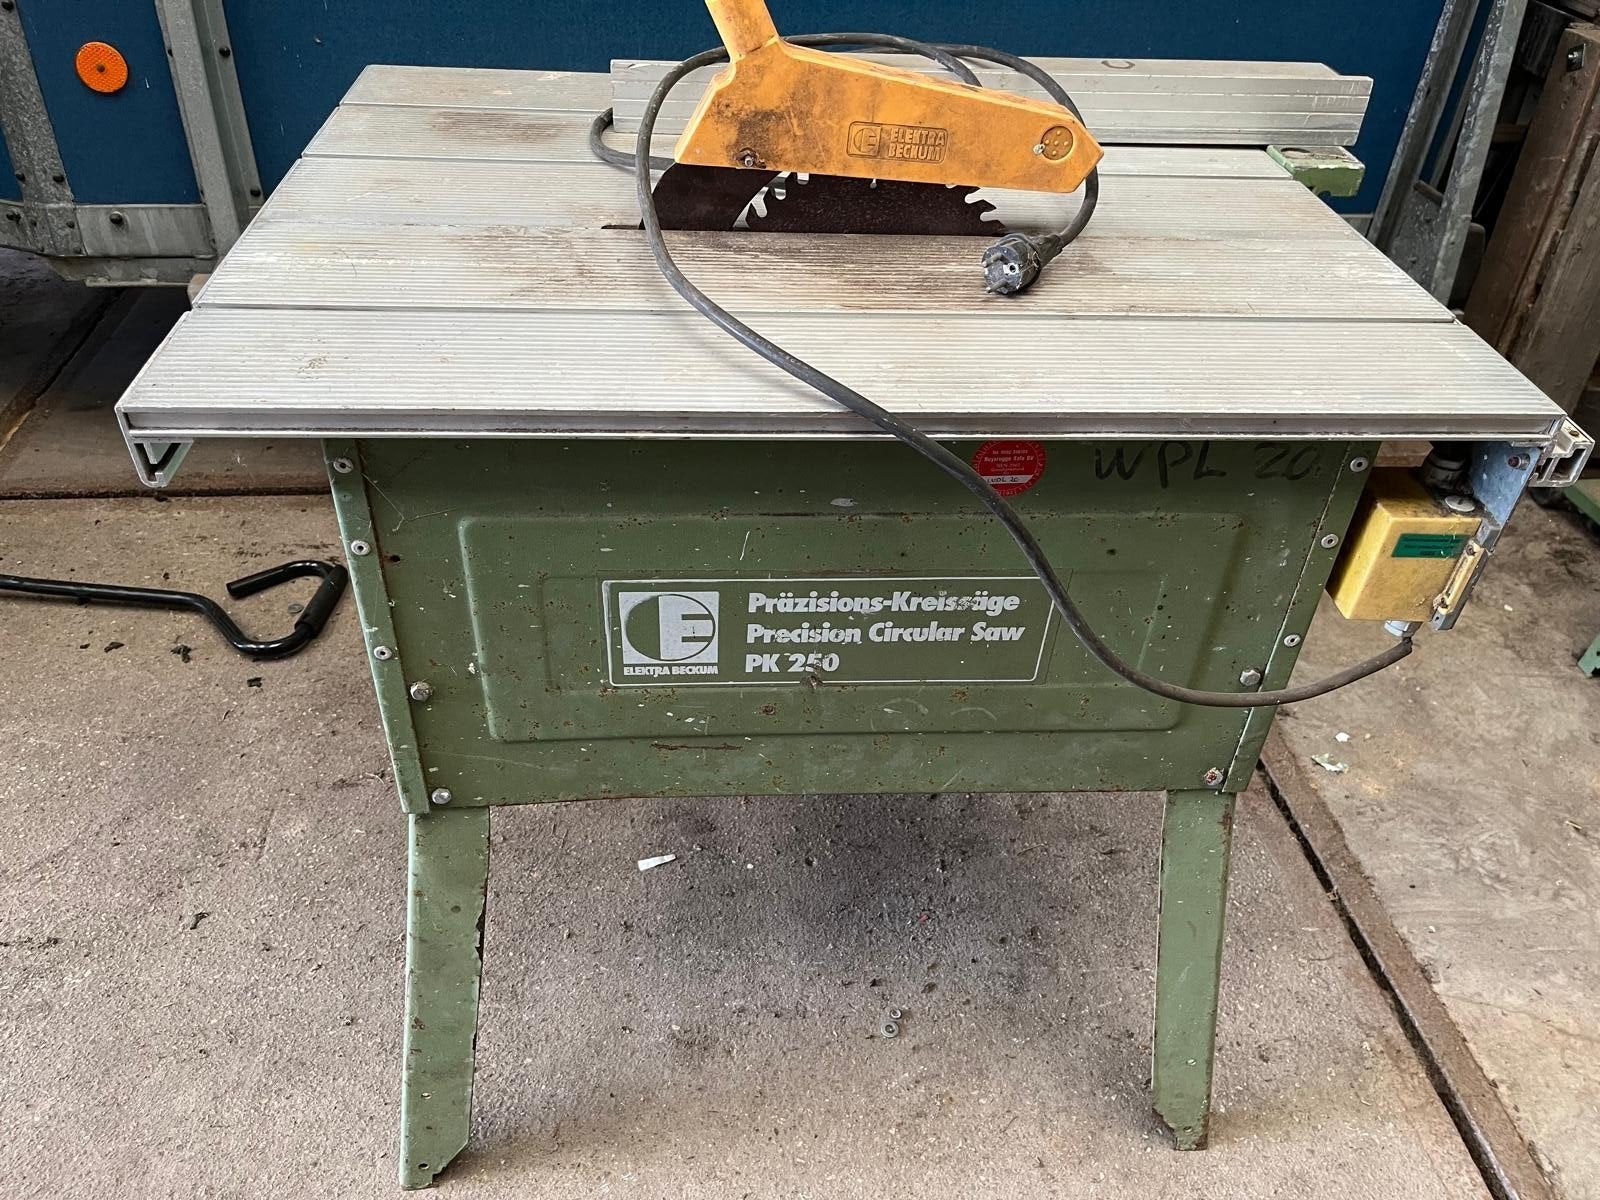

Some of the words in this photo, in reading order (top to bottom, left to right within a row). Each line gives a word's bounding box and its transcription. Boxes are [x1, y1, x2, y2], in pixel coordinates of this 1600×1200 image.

[890, 127, 946, 146] ELEKTRA
[888, 143, 941, 161] BECKUM
[1095, 440, 1227, 488] WPL
[748, 590, 1020, 616] Präzisions-Kreissäge
[746, 621, 862, 643] Precision
[868, 621, 966, 642] Circular
[970, 621, 1026, 641] Saw
[623, 666, 670, 676] ELEKTRA
[671, 665, 719, 675] BECKUM
[745, 653, 780, 673] PK
[787, 652, 840, 673] 250
